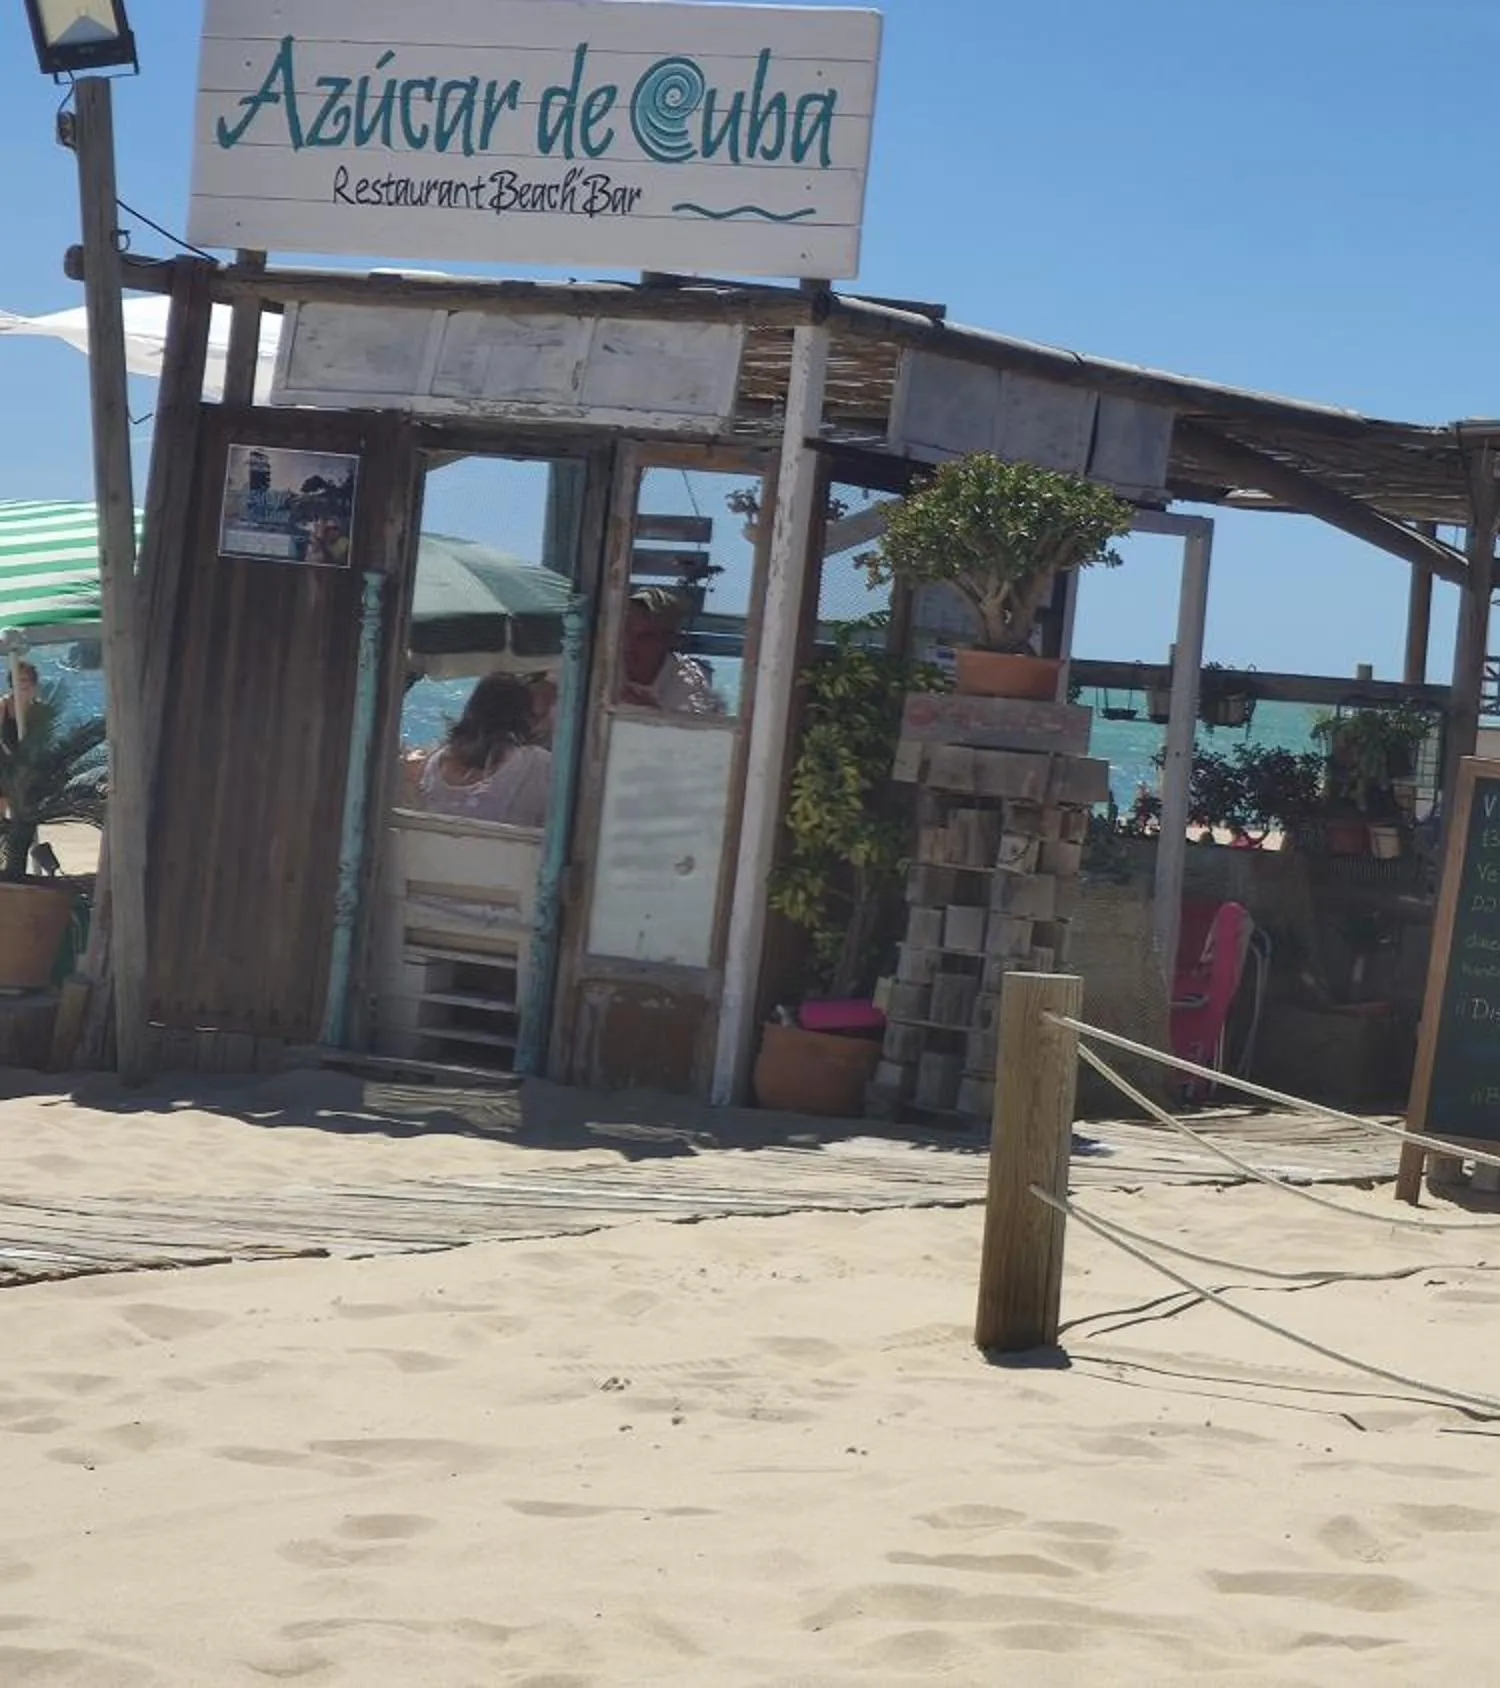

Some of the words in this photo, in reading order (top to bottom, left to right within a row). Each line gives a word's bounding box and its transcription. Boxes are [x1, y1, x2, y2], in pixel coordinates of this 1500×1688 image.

[217, 35, 521, 157] Azúcar
[539, 42, 618, 159] de
[630, 48, 838, 168] Cuba
[332, 164, 486, 210] Restaurant
[582, 173, 643, 218] Bar
